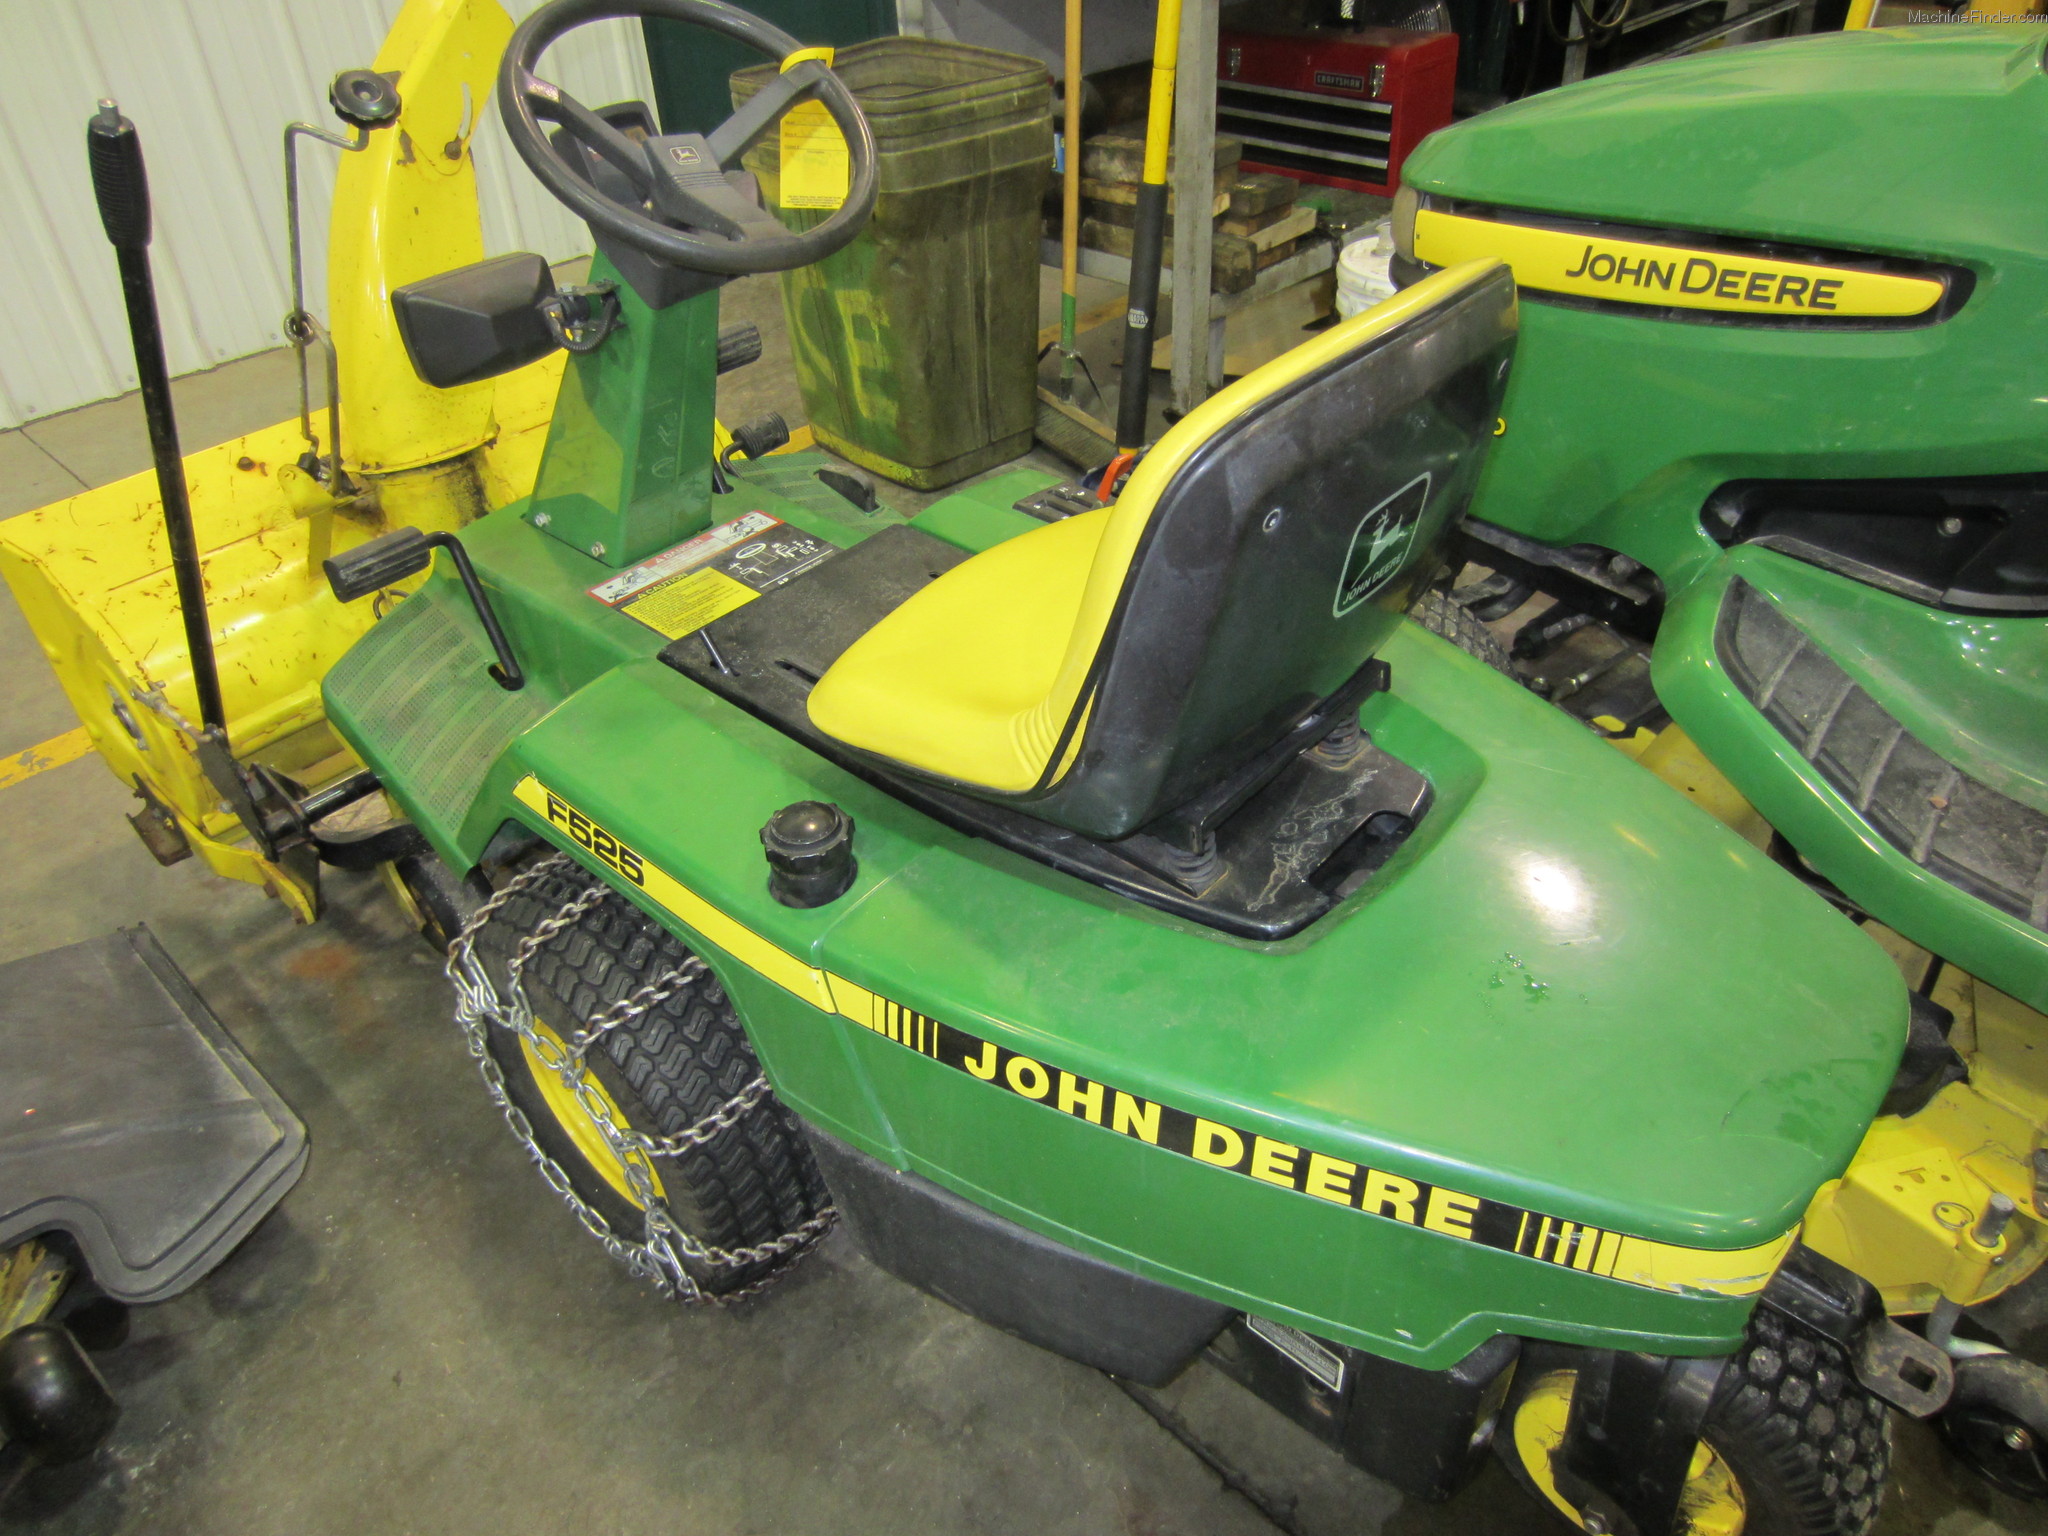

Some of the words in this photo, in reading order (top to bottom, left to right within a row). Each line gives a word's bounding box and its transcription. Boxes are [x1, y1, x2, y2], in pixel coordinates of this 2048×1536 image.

[1316, 74, 1362, 90] CRAFTSMAN
[1565, 245, 1677, 291] JOHN
[1679, 257, 1844, 310] DEERE
[645, 572, 689, 596] CAUTION
[1343, 576, 1372, 606] JOHN
[1371, 552, 1404, 584] DEERE
[546, 792, 645, 887] F525
[964, 1041, 1161, 1145] JOHN
[1192, 1117, 1480, 1240] DEERE
